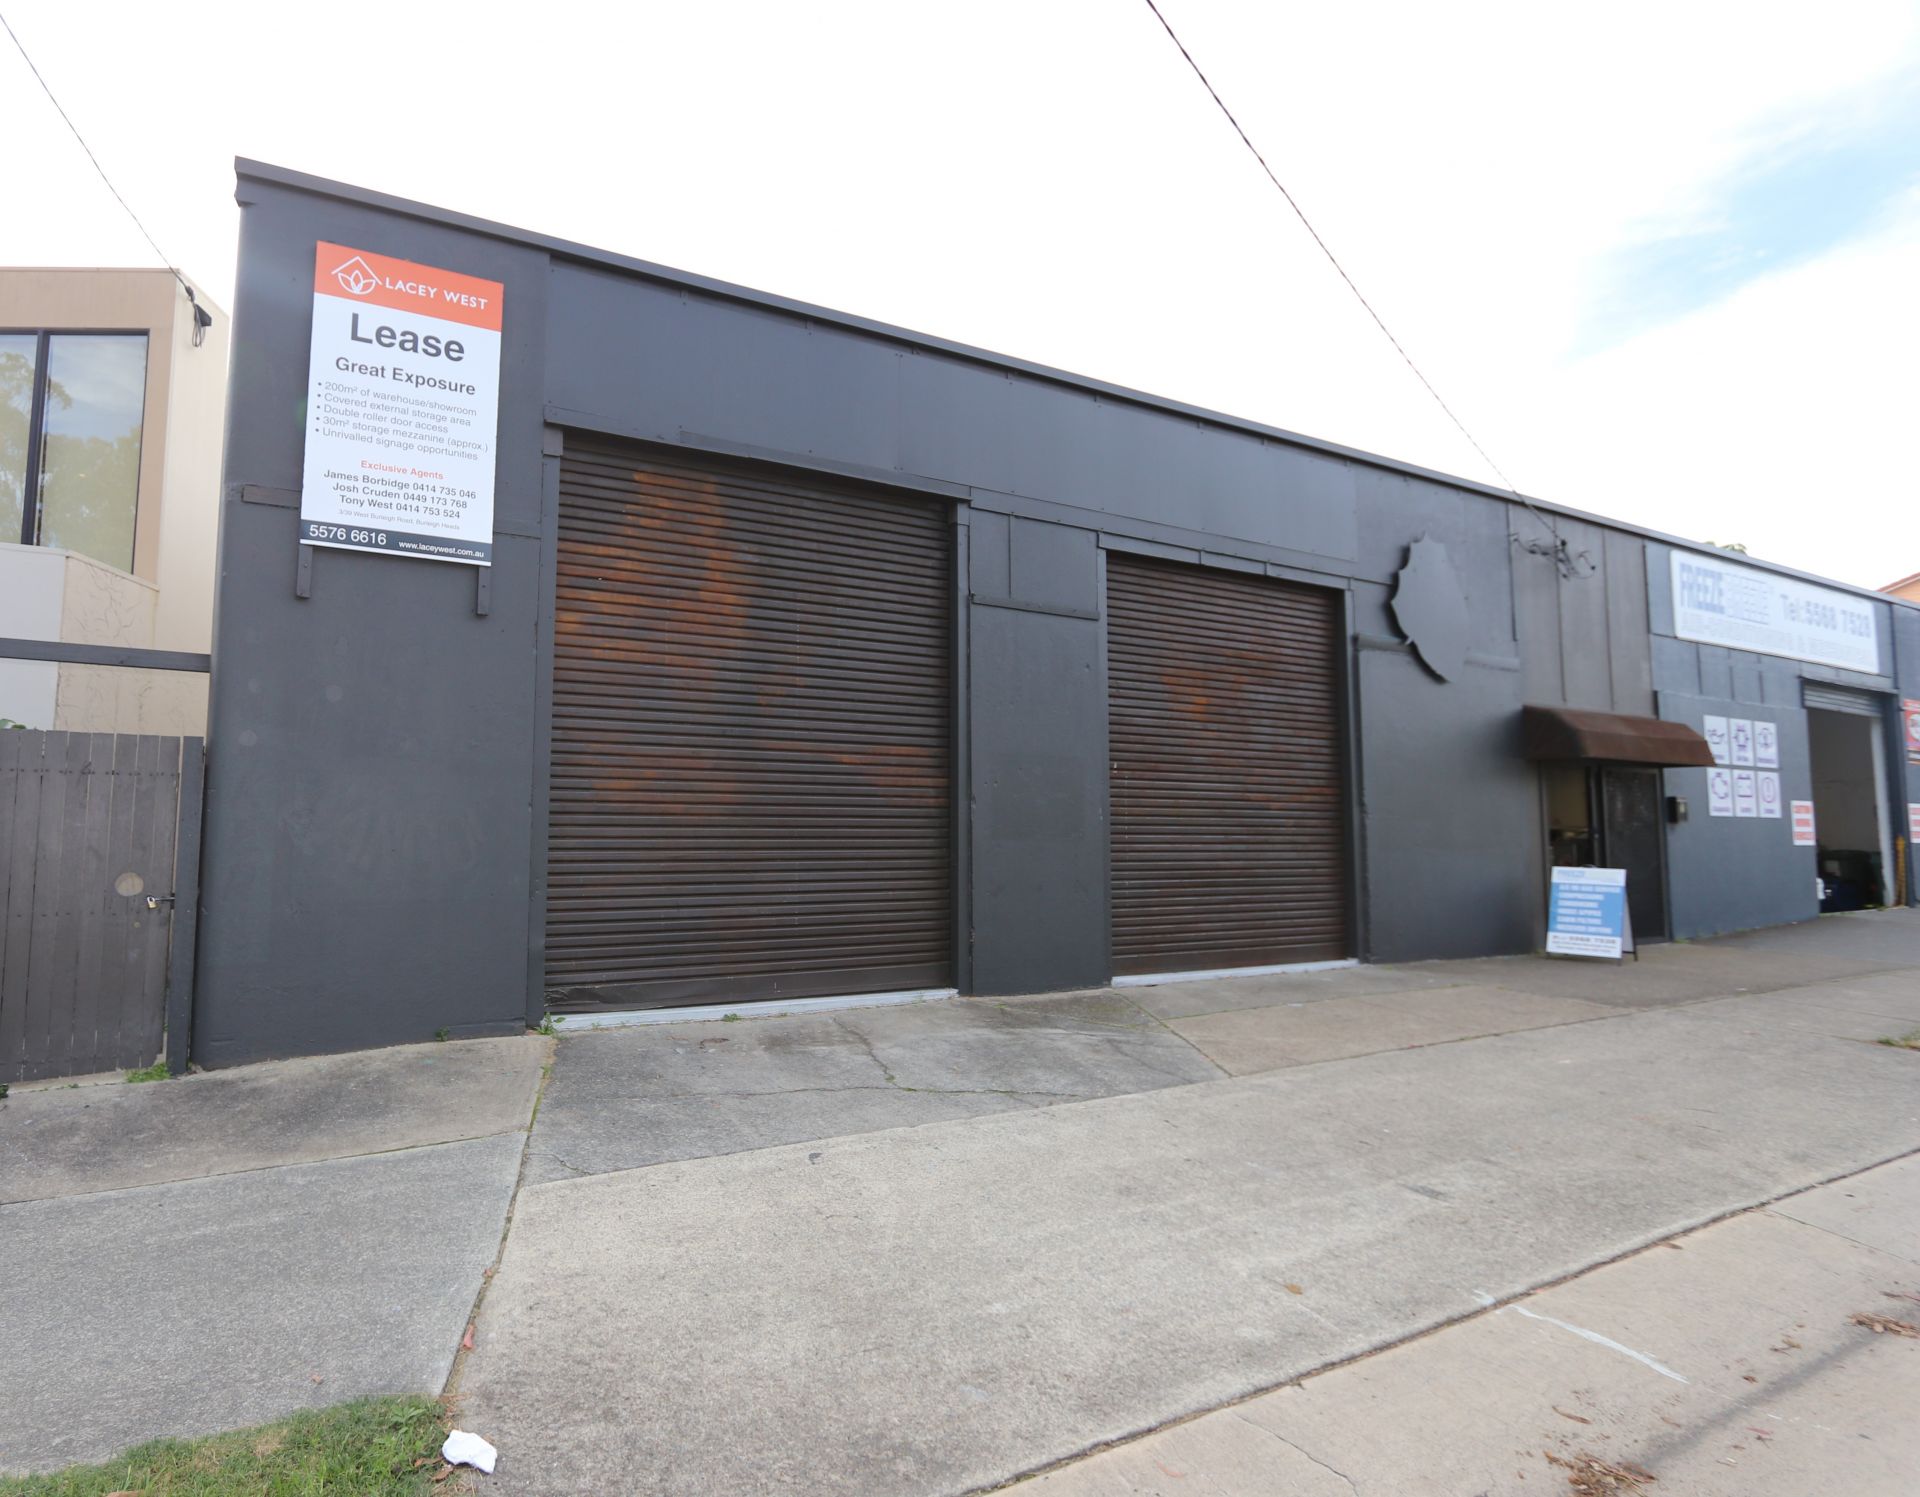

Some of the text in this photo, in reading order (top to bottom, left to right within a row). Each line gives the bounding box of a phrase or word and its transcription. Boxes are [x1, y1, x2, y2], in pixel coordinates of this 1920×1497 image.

[385, 277, 488, 310] LACEY WEST
[350, 312, 465, 362] Lease
[335, 356, 476, 395] Great Exposure
[324, 392, 471, 427] Covered external storage area
[360, 389, 370, 397] of
[373, 391, 477, 416] warehouse/showroom
[324, 404, 449, 433] Double roller door access
[322, 427, 478, 460] Unrivalled signage opportunities
[352, 422, 390, 435] storage
[393, 429, 445, 444] mezzanine
[447, 437, 488, 453] (approx.)
[324, 470, 476, 499] James Borbidge 0414 735 046
[361, 460, 444, 480] Exclusive Agents
[333, 482, 468, 509] Josh Cruden 0449 173 768
[340, 494, 460, 519] Tony West 0414 753 524
[308, 524, 387, 545] 5576 6616
[398, 541, 485, 558] www.laceywest.com.au
